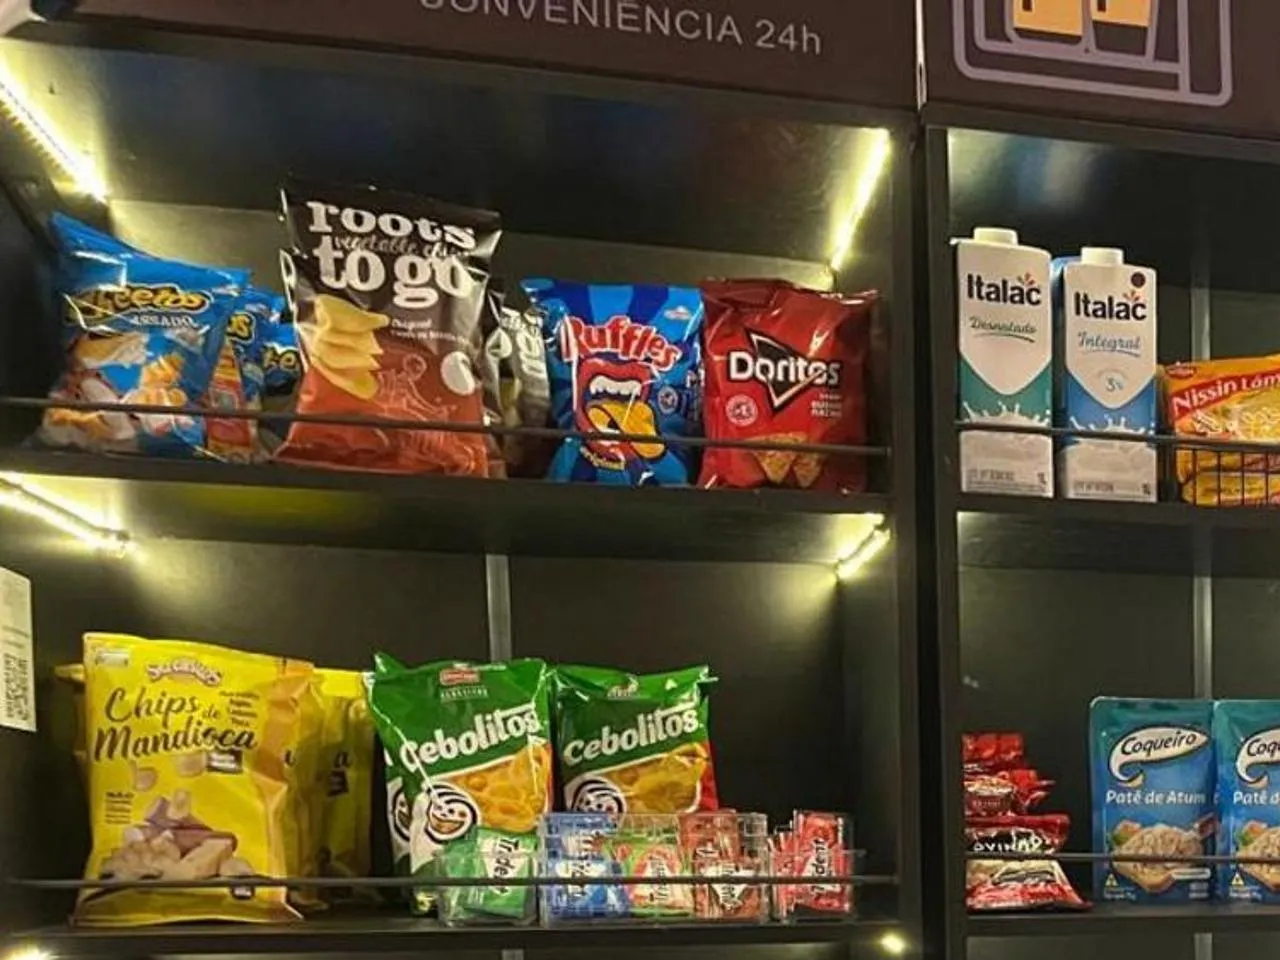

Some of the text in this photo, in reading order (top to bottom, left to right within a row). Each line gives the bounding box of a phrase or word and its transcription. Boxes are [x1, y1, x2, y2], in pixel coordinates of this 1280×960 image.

[755, 19, 821, 55] 24h
[306, 201, 477, 250] roots
[312, 235, 474, 309] to go
[967, 273, 1042, 307] Italac
[1074, 291, 1147, 322] Italac
[561, 316, 682, 373] Ruffles
[1077, 331, 1141, 351] Integral
[729, 350, 841, 386] Doritos
[1171, 379, 1238, 417] Nissin
[104, 686, 198, 729] Chips
[202, 704, 220, 719] de
[93, 716, 259, 762] Mandioca
[400, 701, 541, 772] Cebolitos
[563, 698, 701, 766] Cebolitos
[1120, 730, 1198, 757] Coqueiro
[1145, 790, 1163, 805] de
[1166, 790, 1206, 805] Atum
